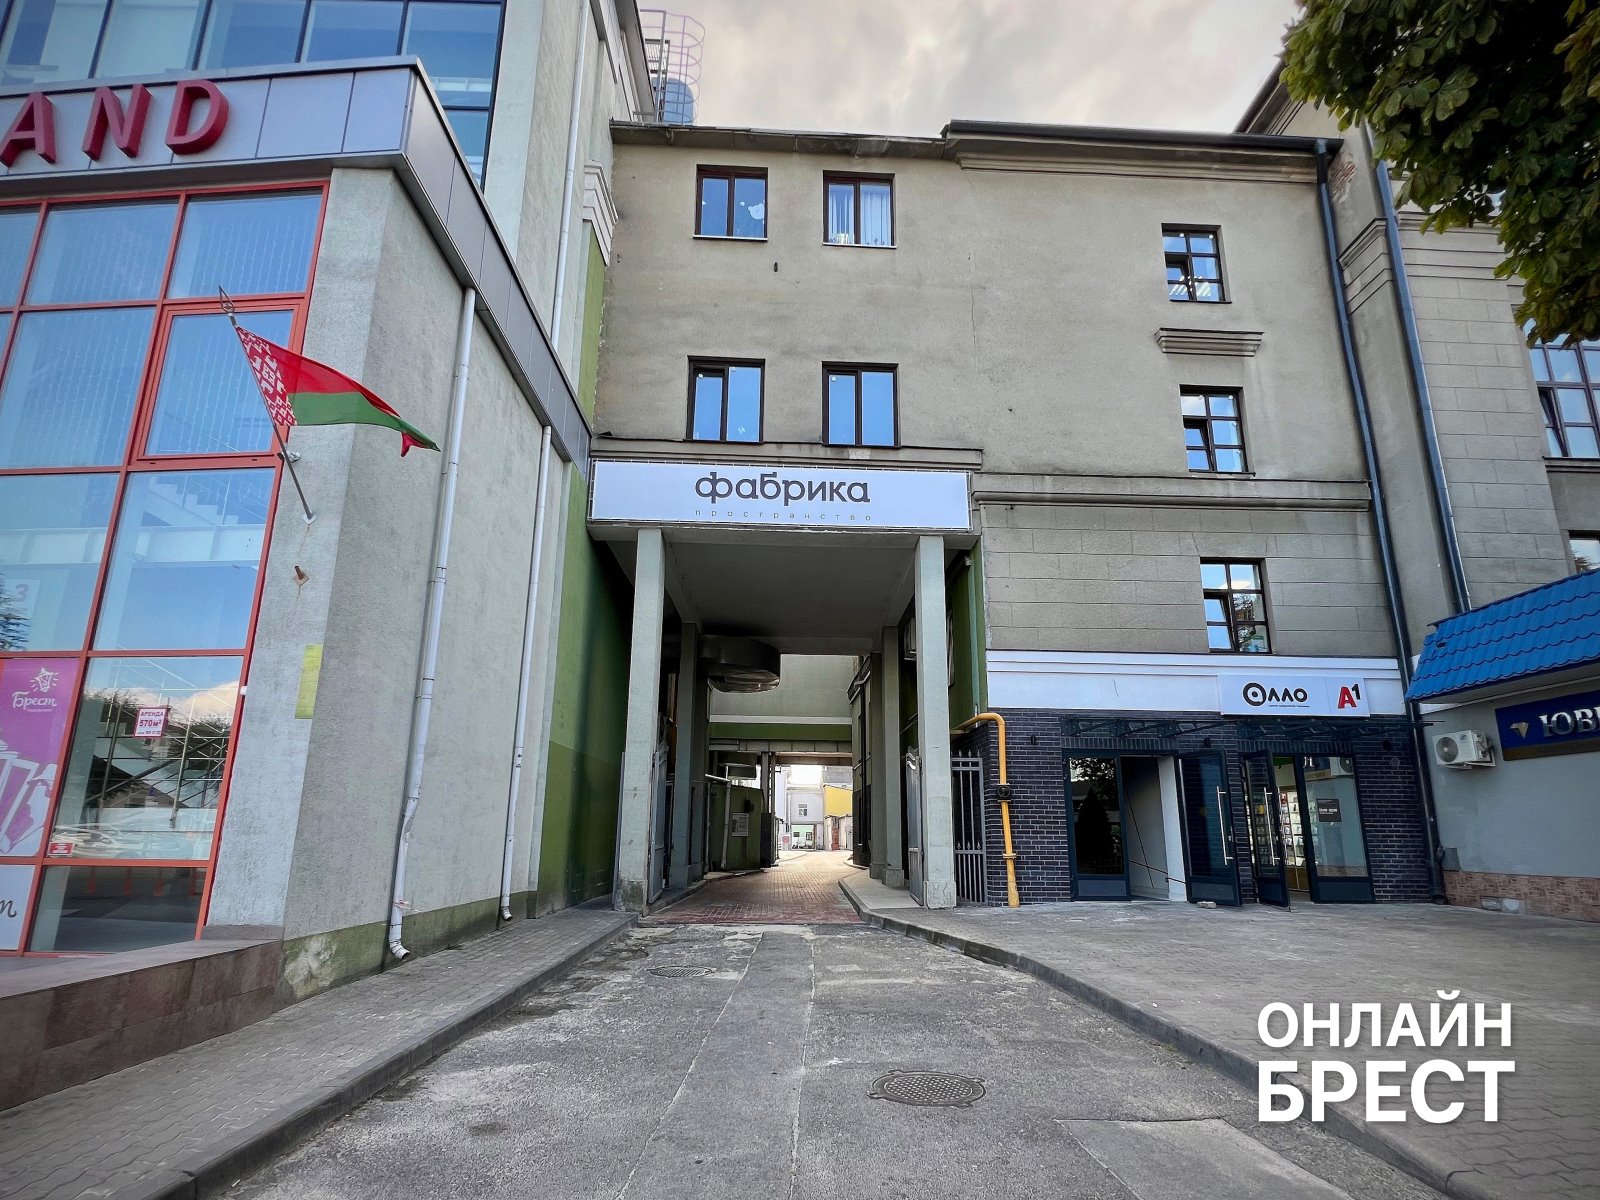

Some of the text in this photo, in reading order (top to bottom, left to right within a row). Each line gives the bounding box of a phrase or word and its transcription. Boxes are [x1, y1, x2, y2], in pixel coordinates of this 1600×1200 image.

[695, 471, 871, 507] фабрика
[695, 509, 872, 521] пространство
[11, 690, 58, 711] Брест
